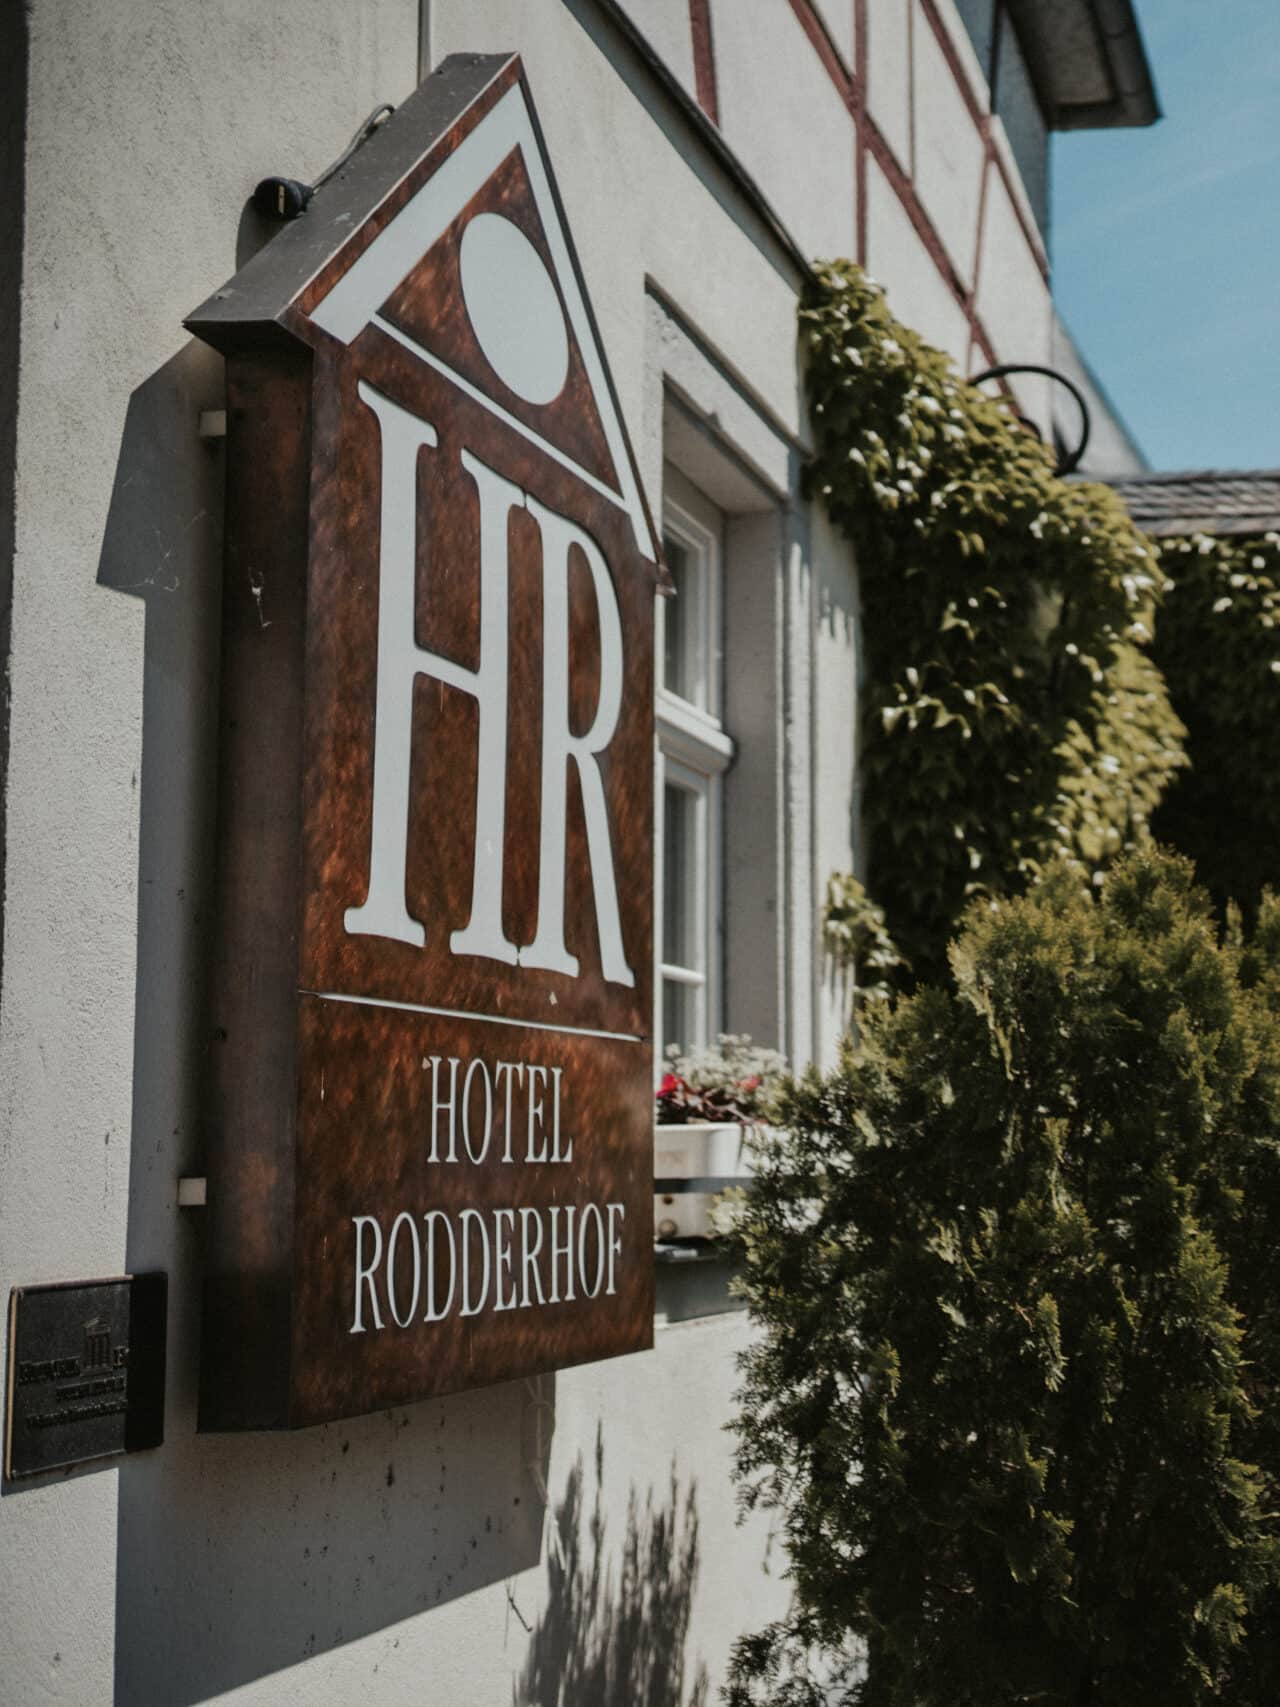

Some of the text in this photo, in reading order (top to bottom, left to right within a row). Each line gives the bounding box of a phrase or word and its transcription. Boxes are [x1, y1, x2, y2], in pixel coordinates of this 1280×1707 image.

[343, 378, 635, 988] HR
[426, 1055, 573, 1165] HOTEL
[348, 1202, 626, 1334] RODDERHOF
